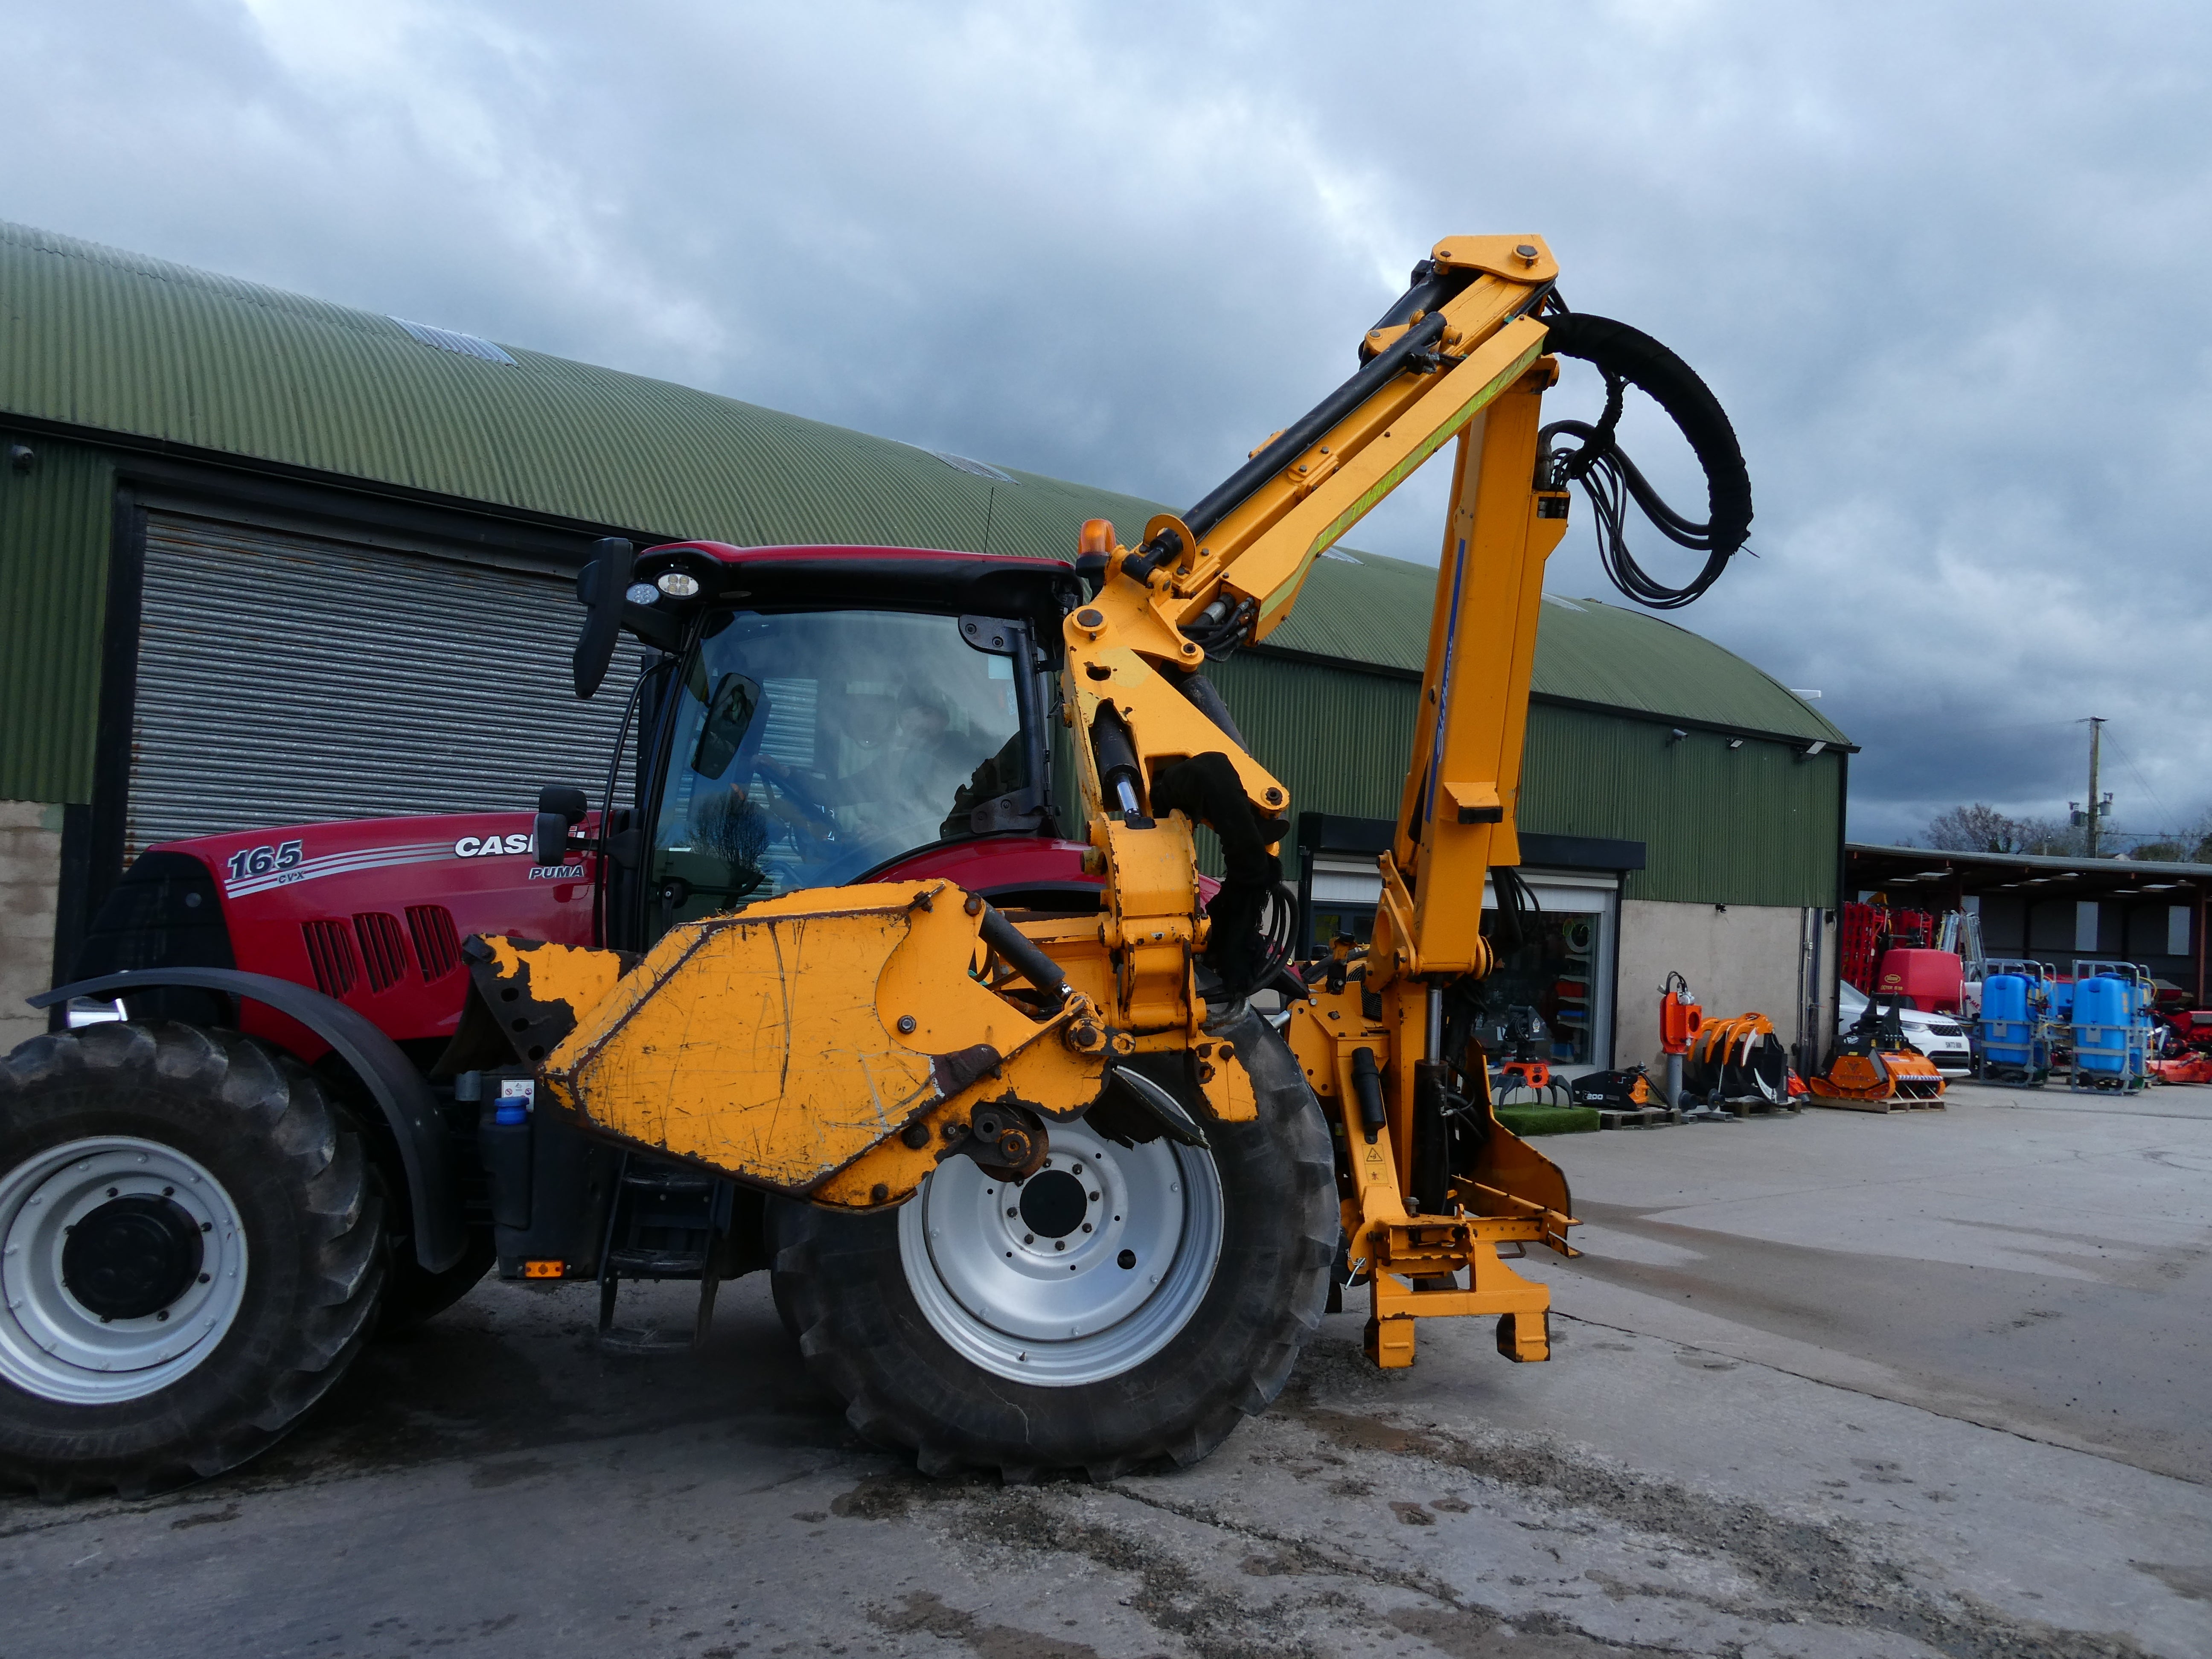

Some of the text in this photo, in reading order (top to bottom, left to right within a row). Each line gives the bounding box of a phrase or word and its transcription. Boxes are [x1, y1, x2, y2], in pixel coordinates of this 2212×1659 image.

[227, 838, 303, 880] 165
[278, 871, 305, 884] CVX
[528, 865, 584, 880] PUMA
